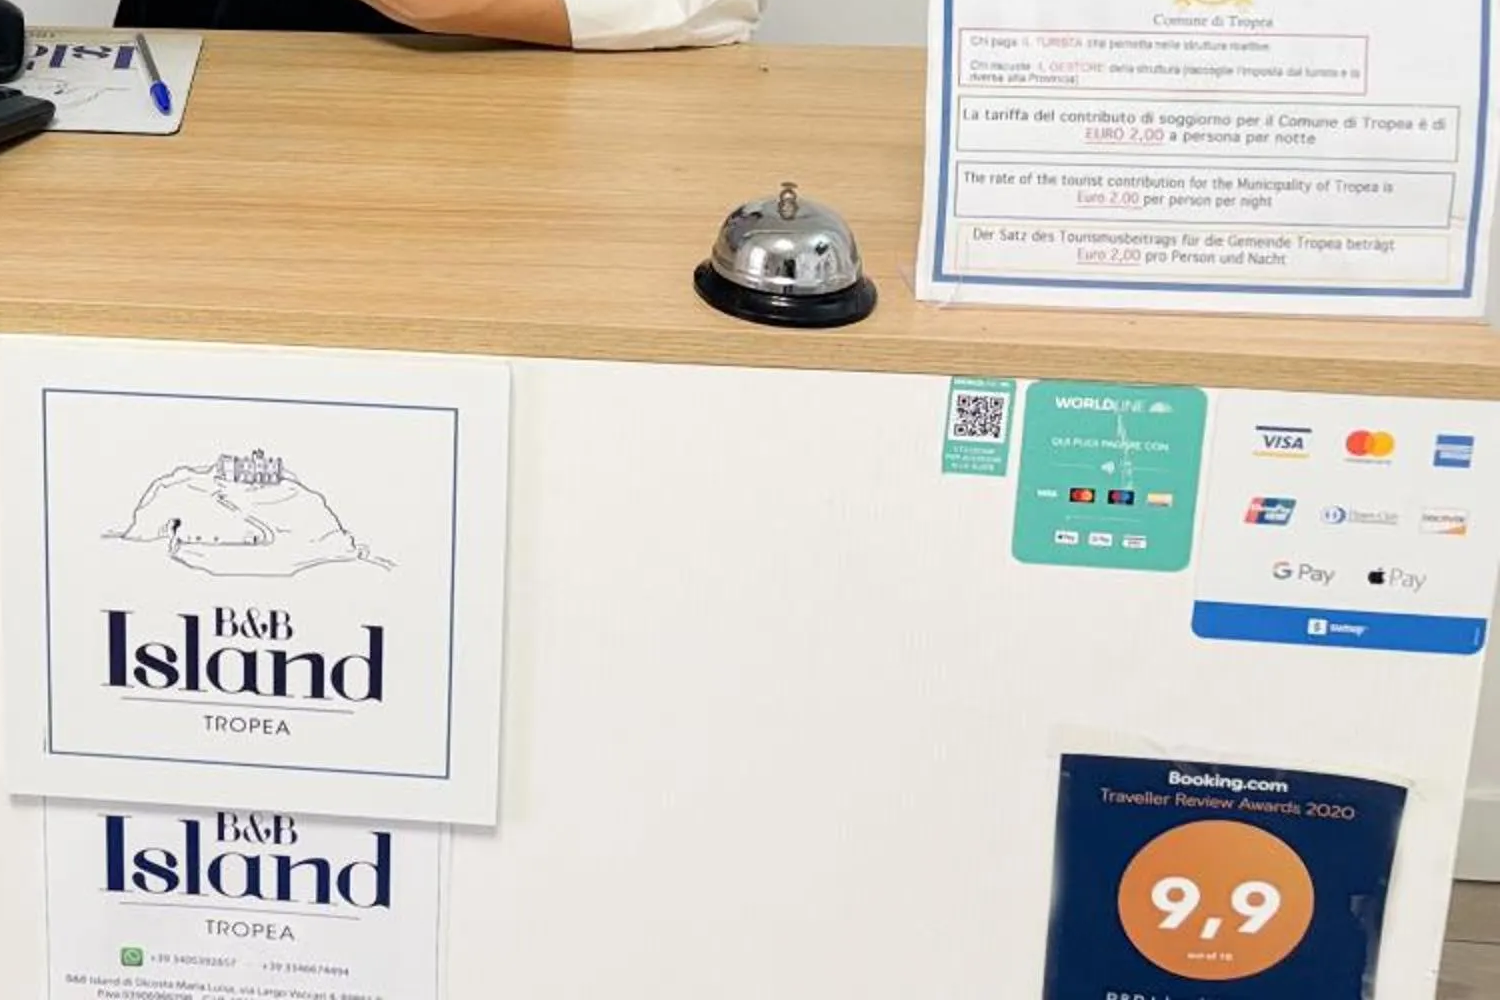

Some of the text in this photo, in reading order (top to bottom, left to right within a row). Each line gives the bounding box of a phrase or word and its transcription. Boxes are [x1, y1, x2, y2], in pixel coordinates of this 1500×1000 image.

[1152, 13, 1274, 30] Comune di Tropea
[963, 108, 1446, 132] La tariffa del contributo di soggiorno per il Comune di Tropea è di
[1085, 128, 1316, 145] EURO 2,00 a persona per notte
[964, 171, 1393, 194] The rate of the tourist contribution for the Municipality of Tropea is
[1077, 191, 1272, 210] Euro per person per night
[973, 227, 1395, 254] Der Satz des Tourismusbeitrags für die Gemeinde Tropea beträgt
[1077, 249, 1286, 266] Euro 2,00 pro Person und Nacht
[1055, 396, 1144, 413] WORLDLINE
[1263, 434, 1304, 449] VISA
[1272, 561, 1335, 587] G Pay
[1389, 567, 1427, 593] Pay
[214, 606, 293, 640] B&B
[101, 609, 385, 703] Island
[203, 715, 291, 736] TROPEA
[1168, 770, 1288, 792] Booking.com
[1100, 787, 1355, 820] Traveller Review Awards 2020
[216, 811, 298, 845] B&B
[99, 814, 391, 909] Island
[1151, 876, 1281, 939] 9,9
[205, 919, 296, 941] TROPEA
